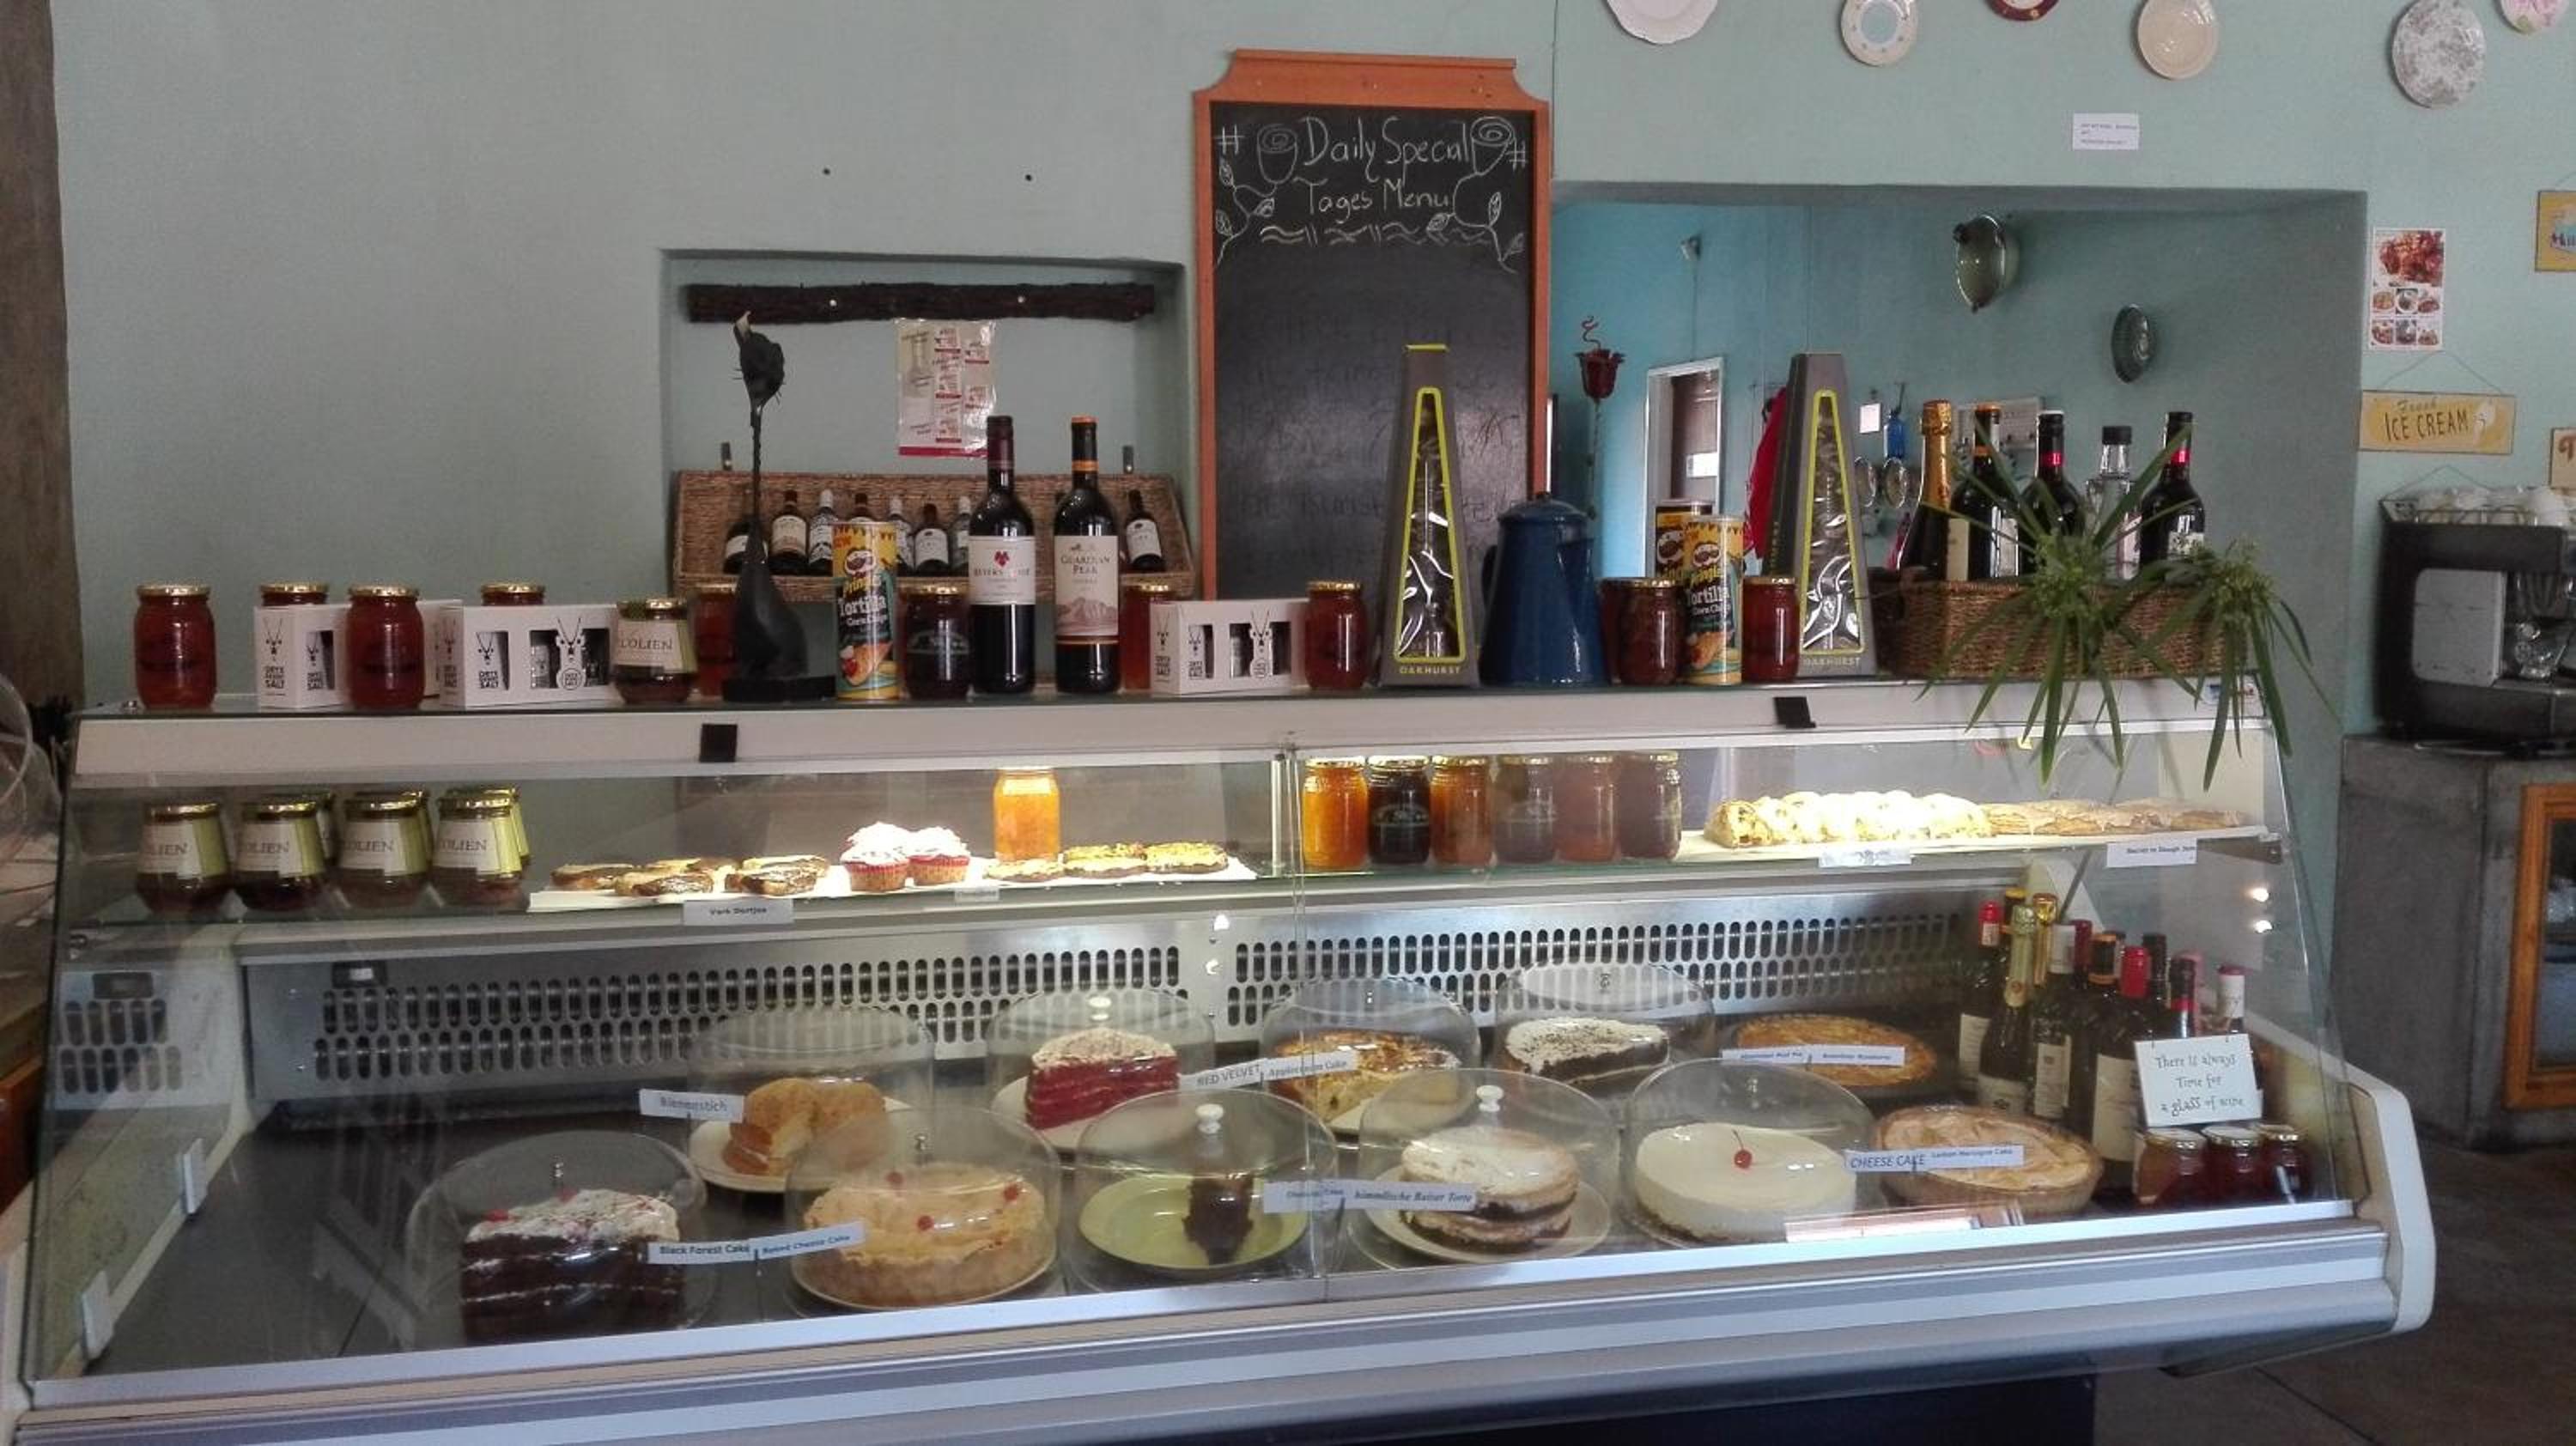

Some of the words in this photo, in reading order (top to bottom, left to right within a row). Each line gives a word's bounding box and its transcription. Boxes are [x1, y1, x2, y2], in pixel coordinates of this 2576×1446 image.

[1302, 116, 1379, 182] Daily
[1294, 176, 1373, 224] Tages
[1382, 177, 1451, 210] Menu
[2384, 411, 2410, 442] ICE
[2416, 409, 2470, 439] CREAM
[1400, 665, 1460, 675] OAKHURST
[2201, 1053, 2236, 1067] always
[1196, 1072, 1219, 1087] RED
[1223, 1063, 1261, 1082] VELVET
[2175, 1076, 2202, 1088] Time
[1850, 1156, 1893, 1169] CHEESE
[1896, 1153, 1925, 1166] CAKE
[659, 1246, 686, 1255] Black
[690, 1245, 723, 1255] Forest
[726, 1244, 750, 1254] Cake
